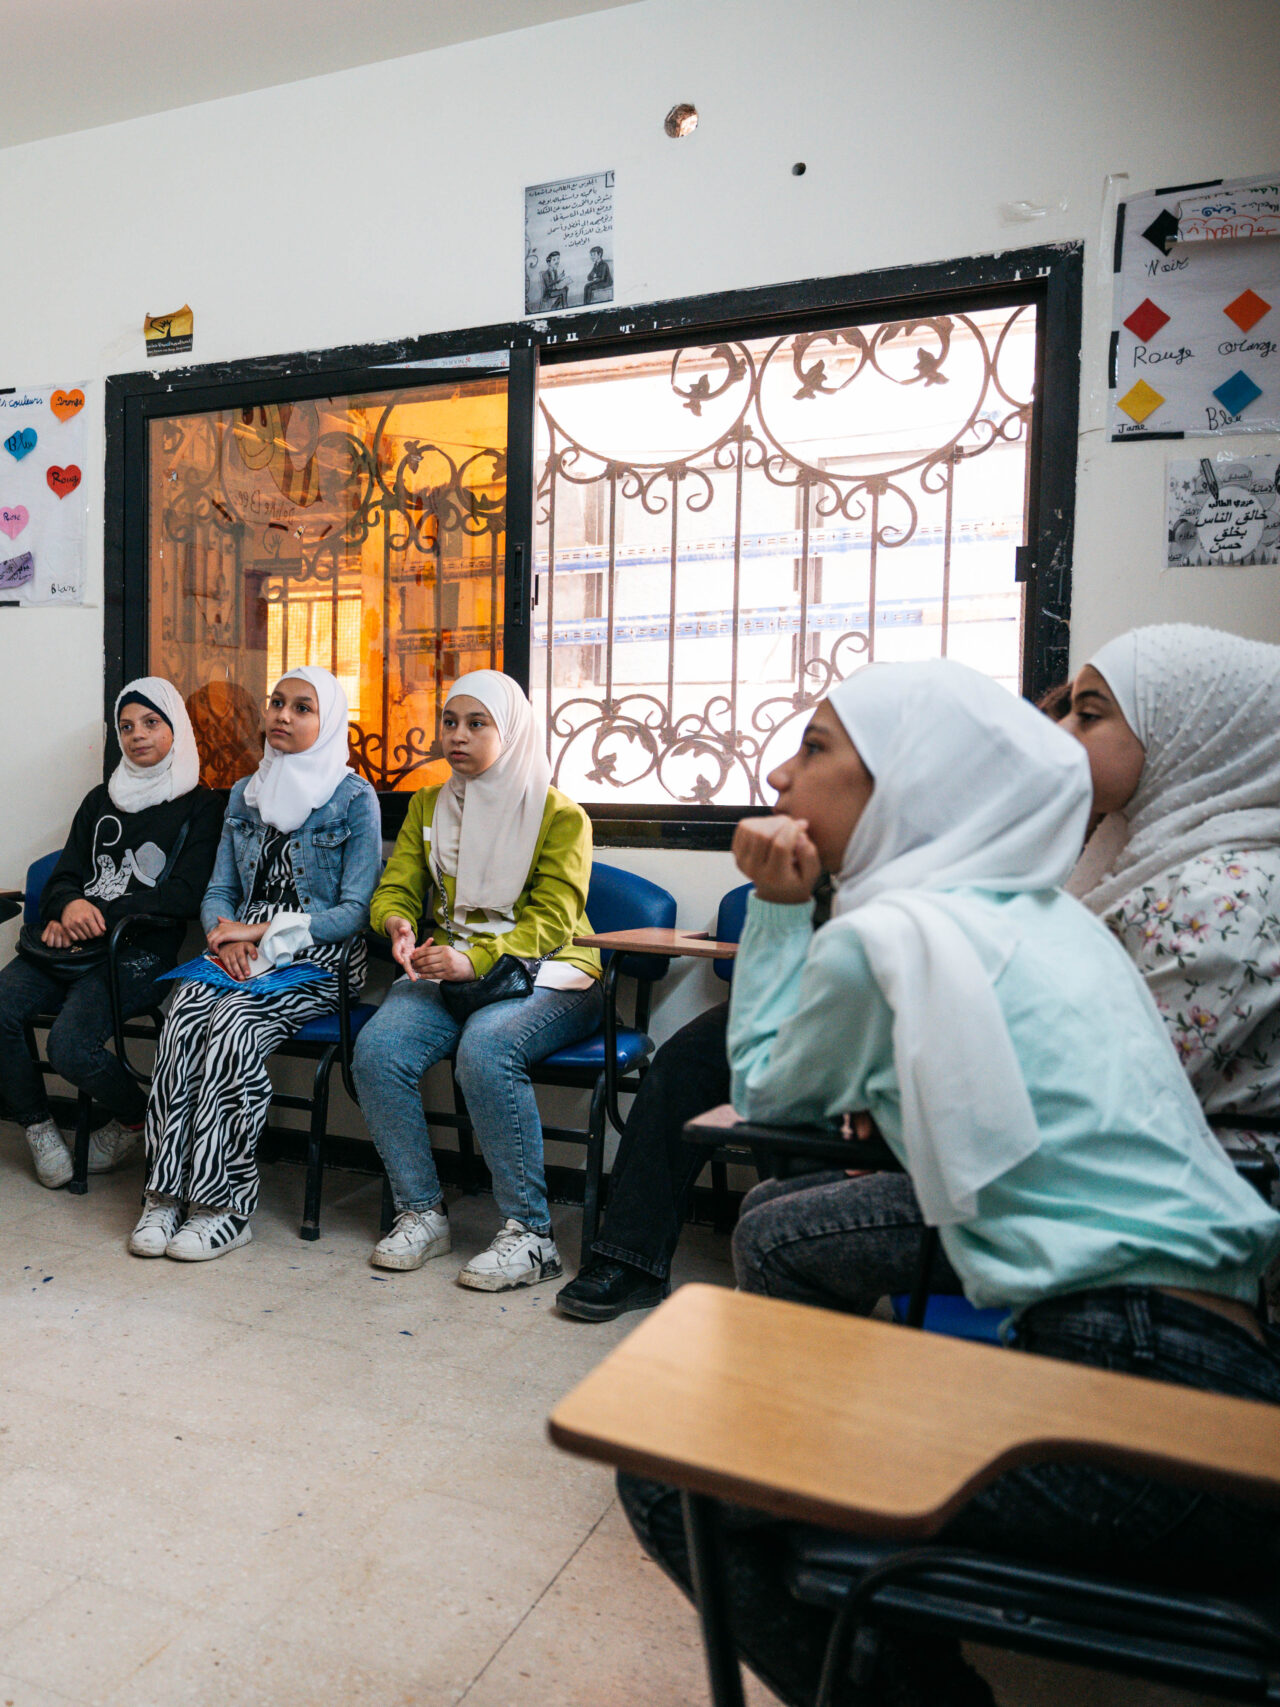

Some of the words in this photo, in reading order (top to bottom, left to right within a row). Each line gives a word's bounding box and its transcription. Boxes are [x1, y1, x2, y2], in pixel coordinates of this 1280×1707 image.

[1133, 346, 1196, 368] Rouge
[9, 394, 44, 408] couleurs
[1205, 407, 1243, 431] Bleu
[1208, 498, 1233, 509] الطالب
[1195, 512, 1233, 528] الناس
[1235, 509, 1268, 526] خالق
[1213, 526, 1248, 542] بخلق
[1209, 542, 1243, 554] حسن
